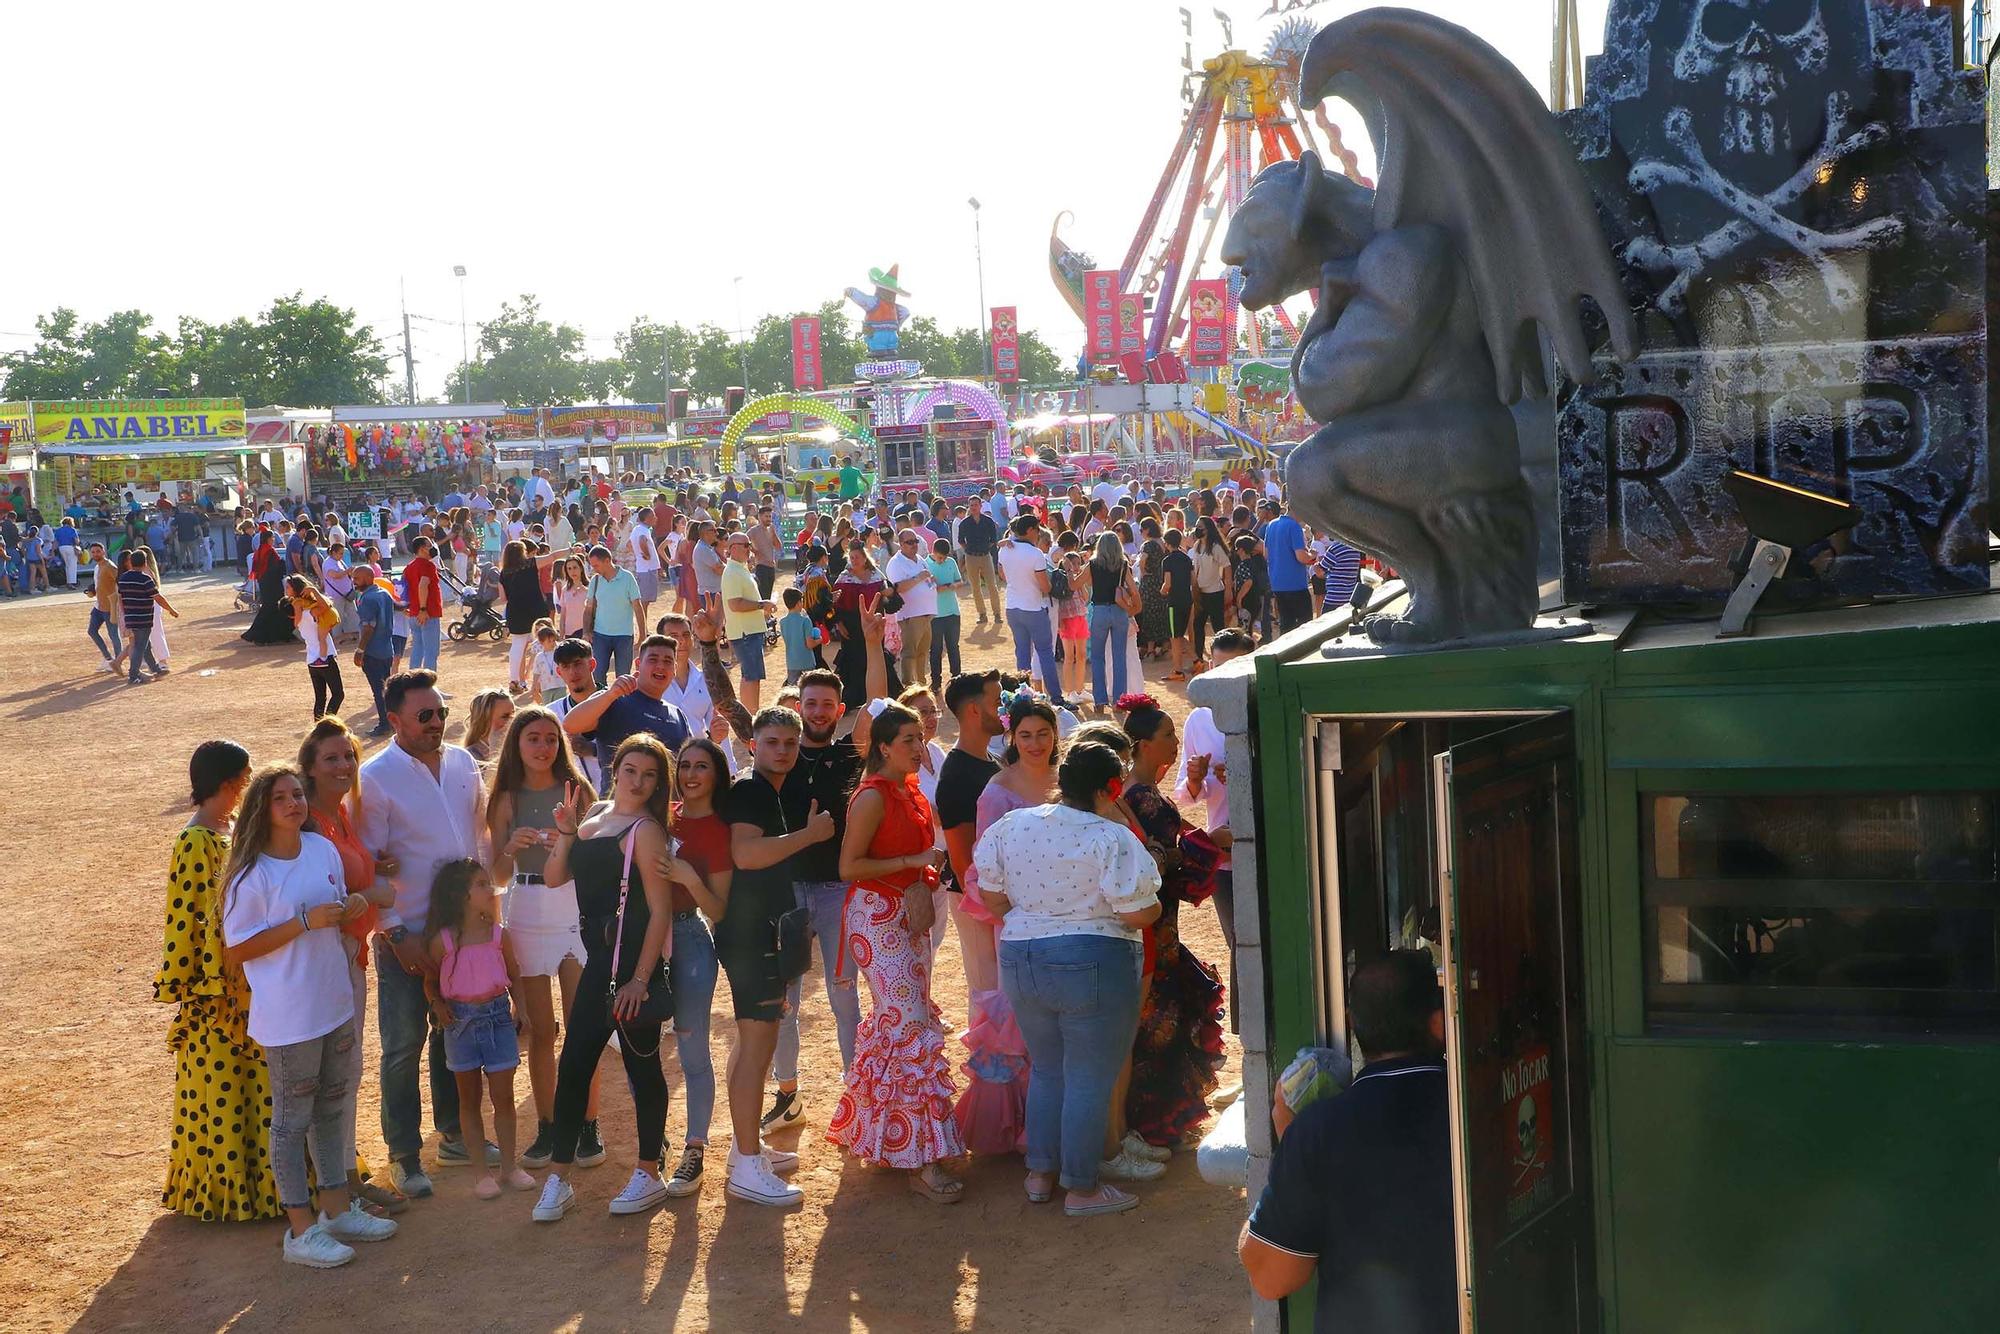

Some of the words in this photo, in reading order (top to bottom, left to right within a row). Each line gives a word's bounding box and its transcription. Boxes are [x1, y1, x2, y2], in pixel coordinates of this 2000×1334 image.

[36, 400, 157, 413] BAGUETTERIA
[164, 399, 242, 412] BURGUER
[767, 413, 791, 427] ENTRADA
[65, 415, 218, 440] ANABEL
